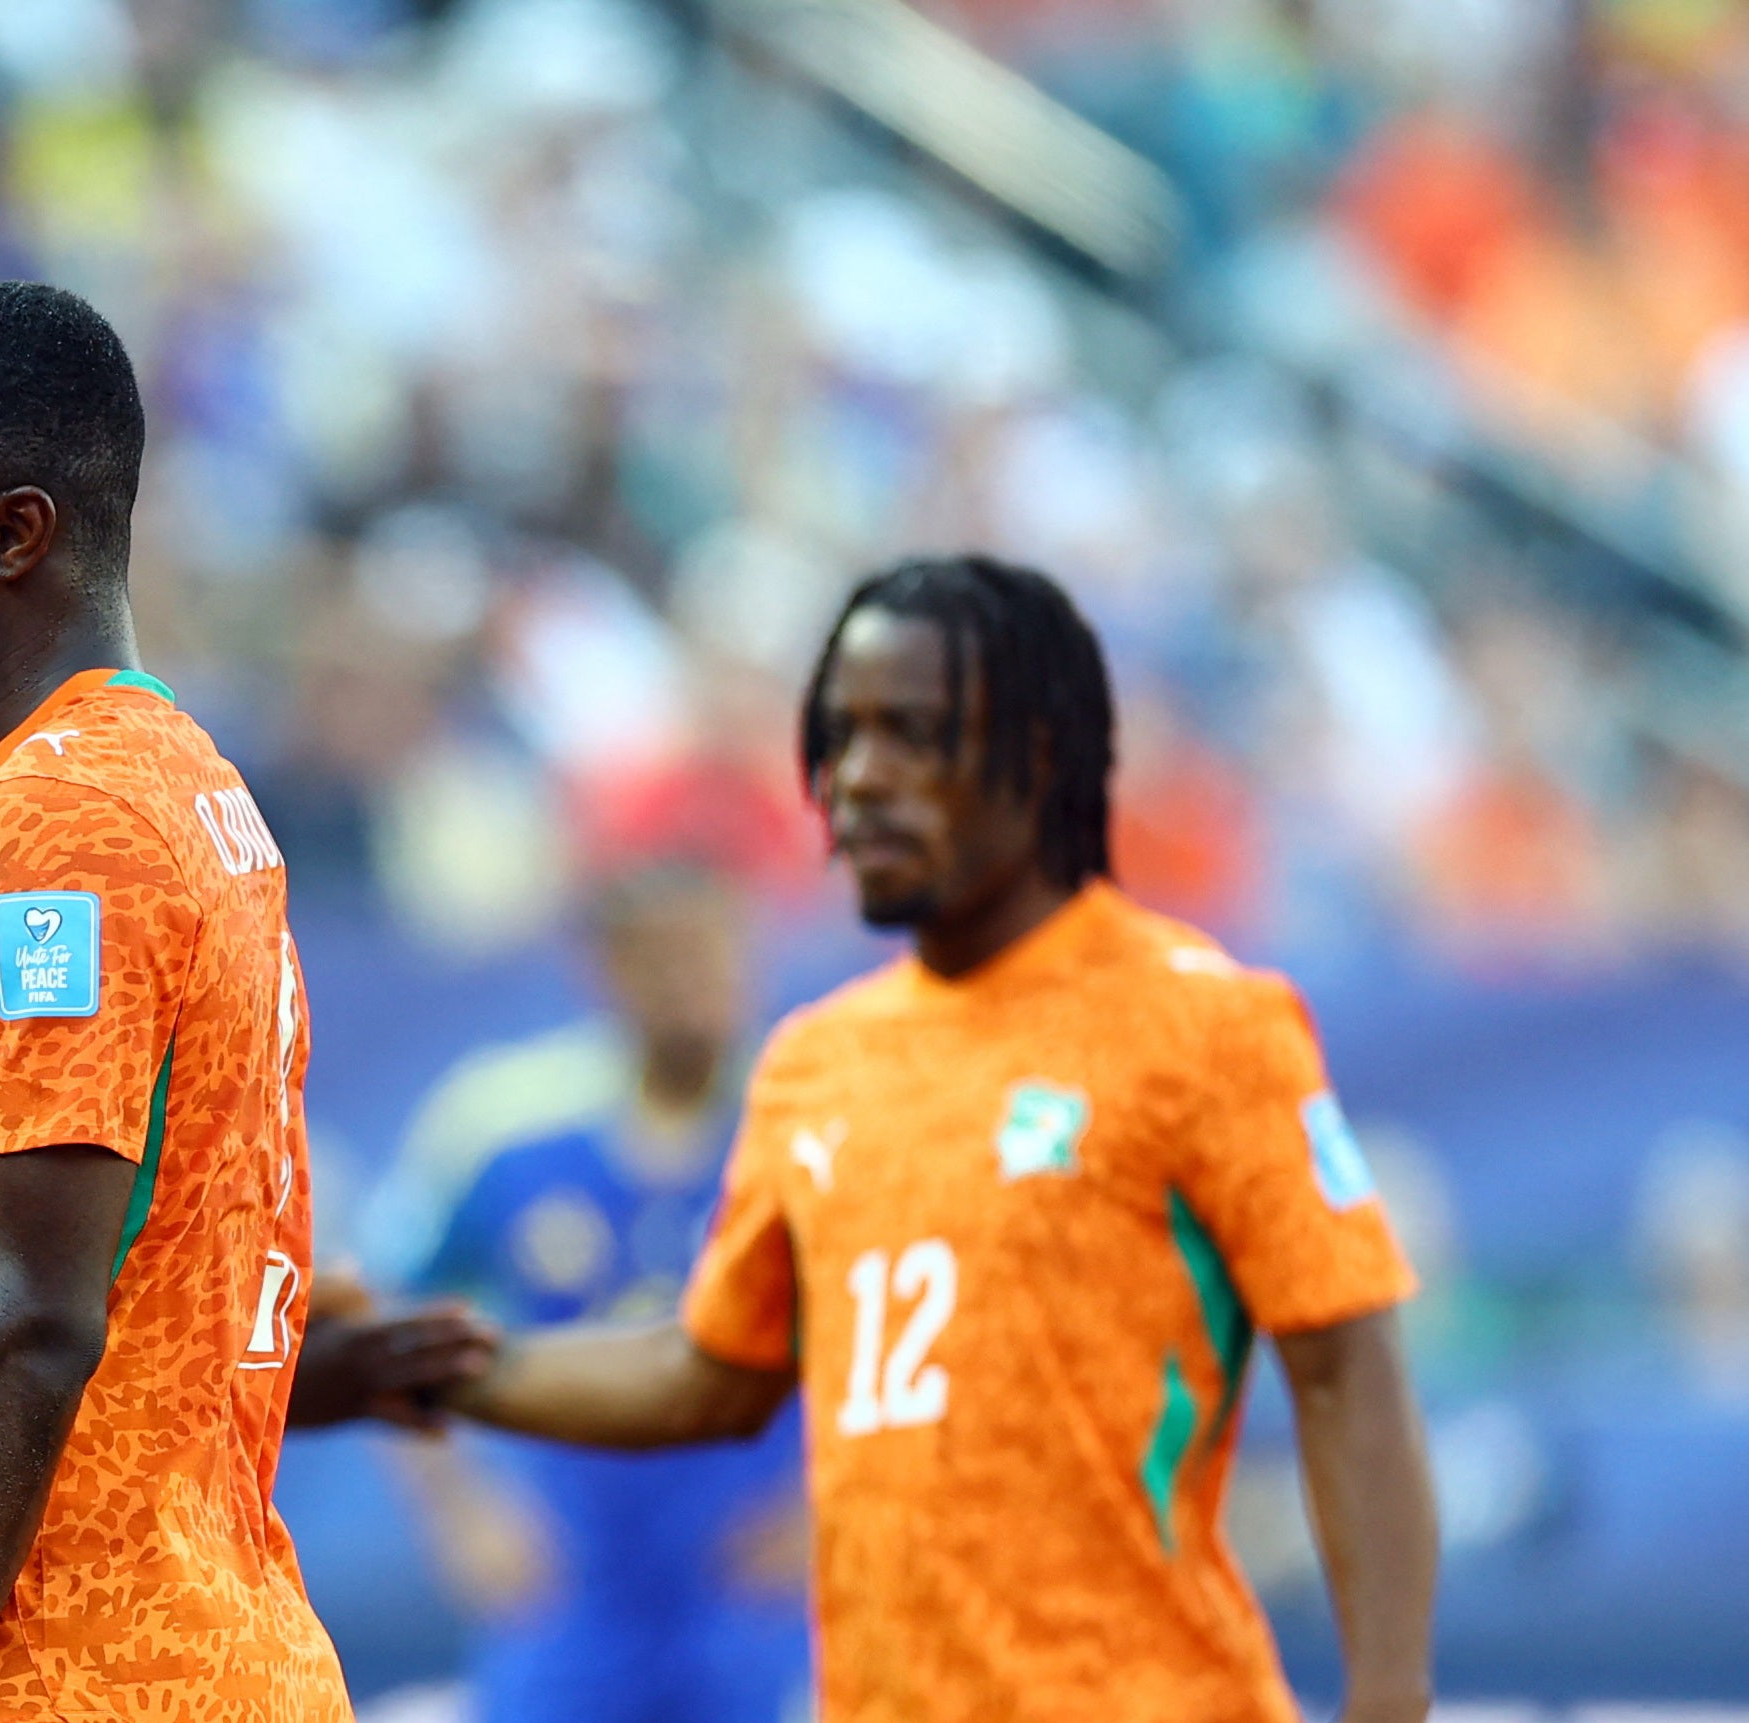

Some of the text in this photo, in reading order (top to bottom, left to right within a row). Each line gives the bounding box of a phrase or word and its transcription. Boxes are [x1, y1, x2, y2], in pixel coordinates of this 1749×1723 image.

[15, 945, 73, 969] Unite For
[21, 967, 68, 990] PEACE
[28, 991, 57, 1003] FIFA
[836, 1237, 960, 1437] 12
